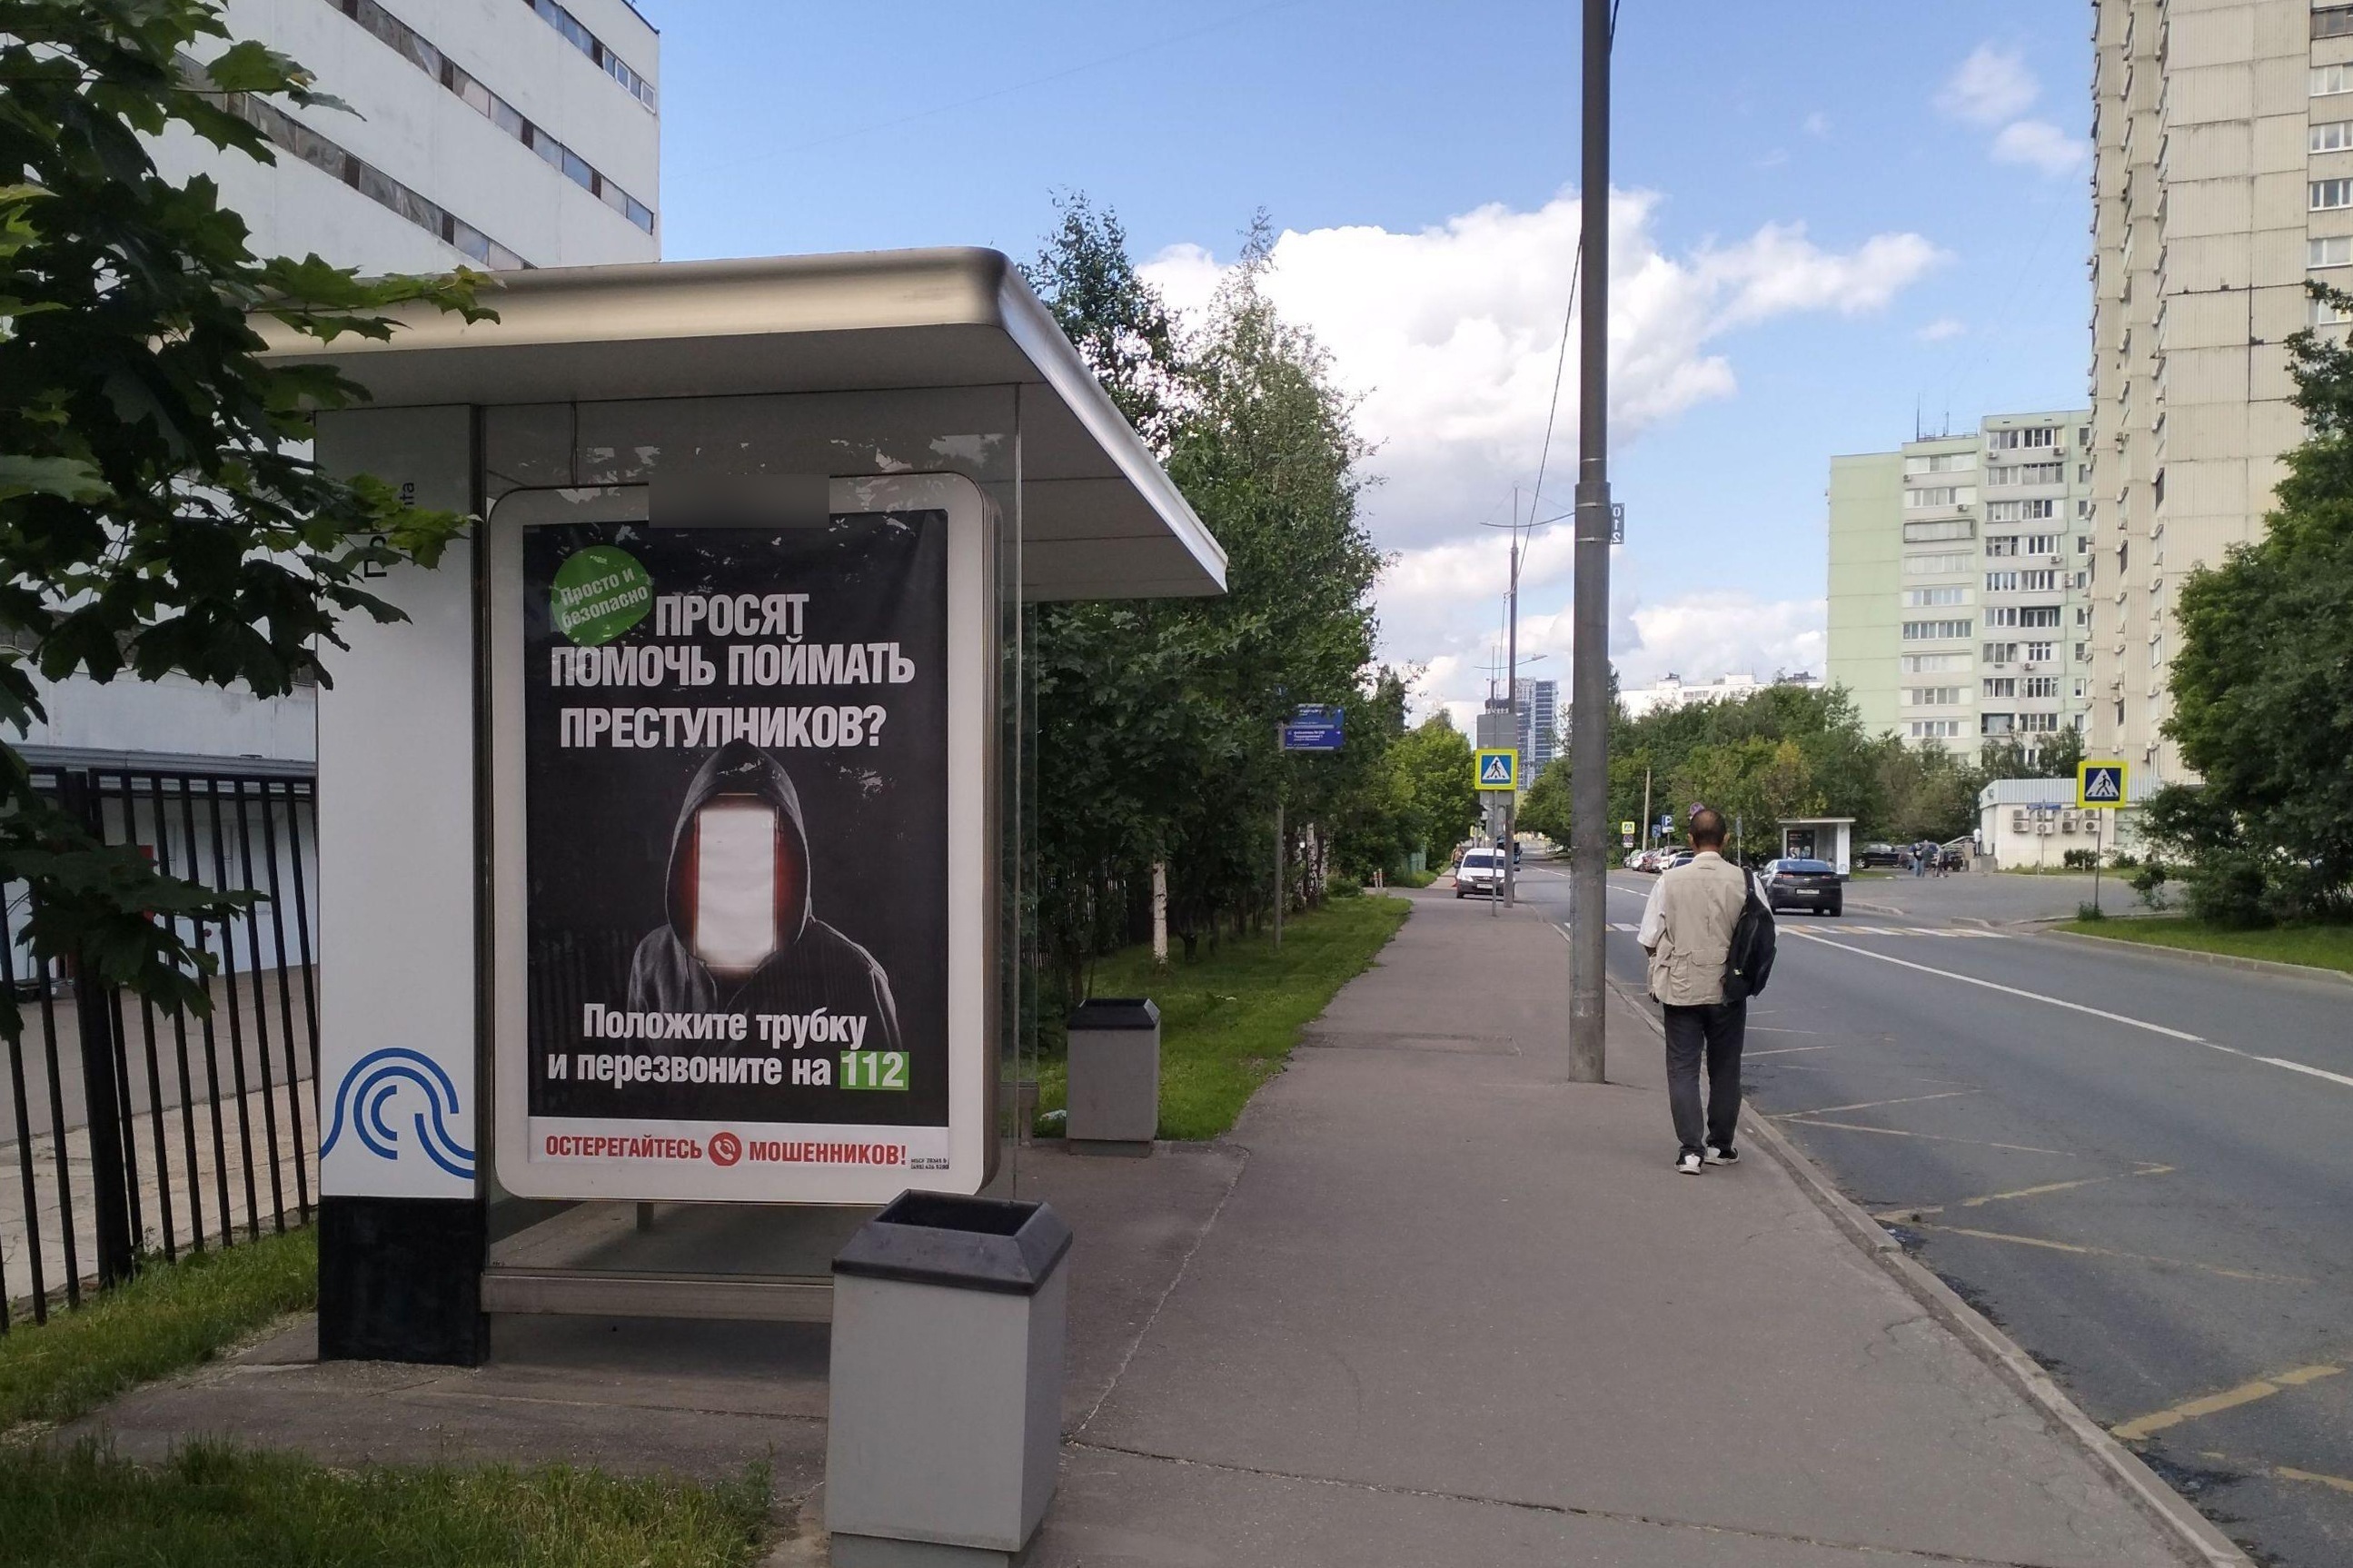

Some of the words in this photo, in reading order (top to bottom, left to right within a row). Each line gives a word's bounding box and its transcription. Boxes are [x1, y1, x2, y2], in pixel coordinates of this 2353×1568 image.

[561, 573, 620, 606] Просто
[621, 568, 635, 583] и
[561, 586, 649, 629] безопасно
[656, 593, 809, 637] ПРОСЯТ
[551, 645, 717, 687] ПОМОЧЬ
[729, 635, 916, 687] ПОЙМАТЬ
[561, 704, 887, 749] ПРЕСТУПНИКОВ?
[583, 1003, 748, 1041] Положите
[756, 1007, 867, 1050] трубку
[548, 1054, 568, 1080] и
[577, 1054, 782, 1089] перезвоните
[792, 1057, 831, 1087] на
[840, 1052, 904, 1087] 112
[545, 1134, 702, 1159] ОСТЕРЕГАЙТЕСЬ
[749, 1141, 906, 1166] МОШЕННИКОВ!
